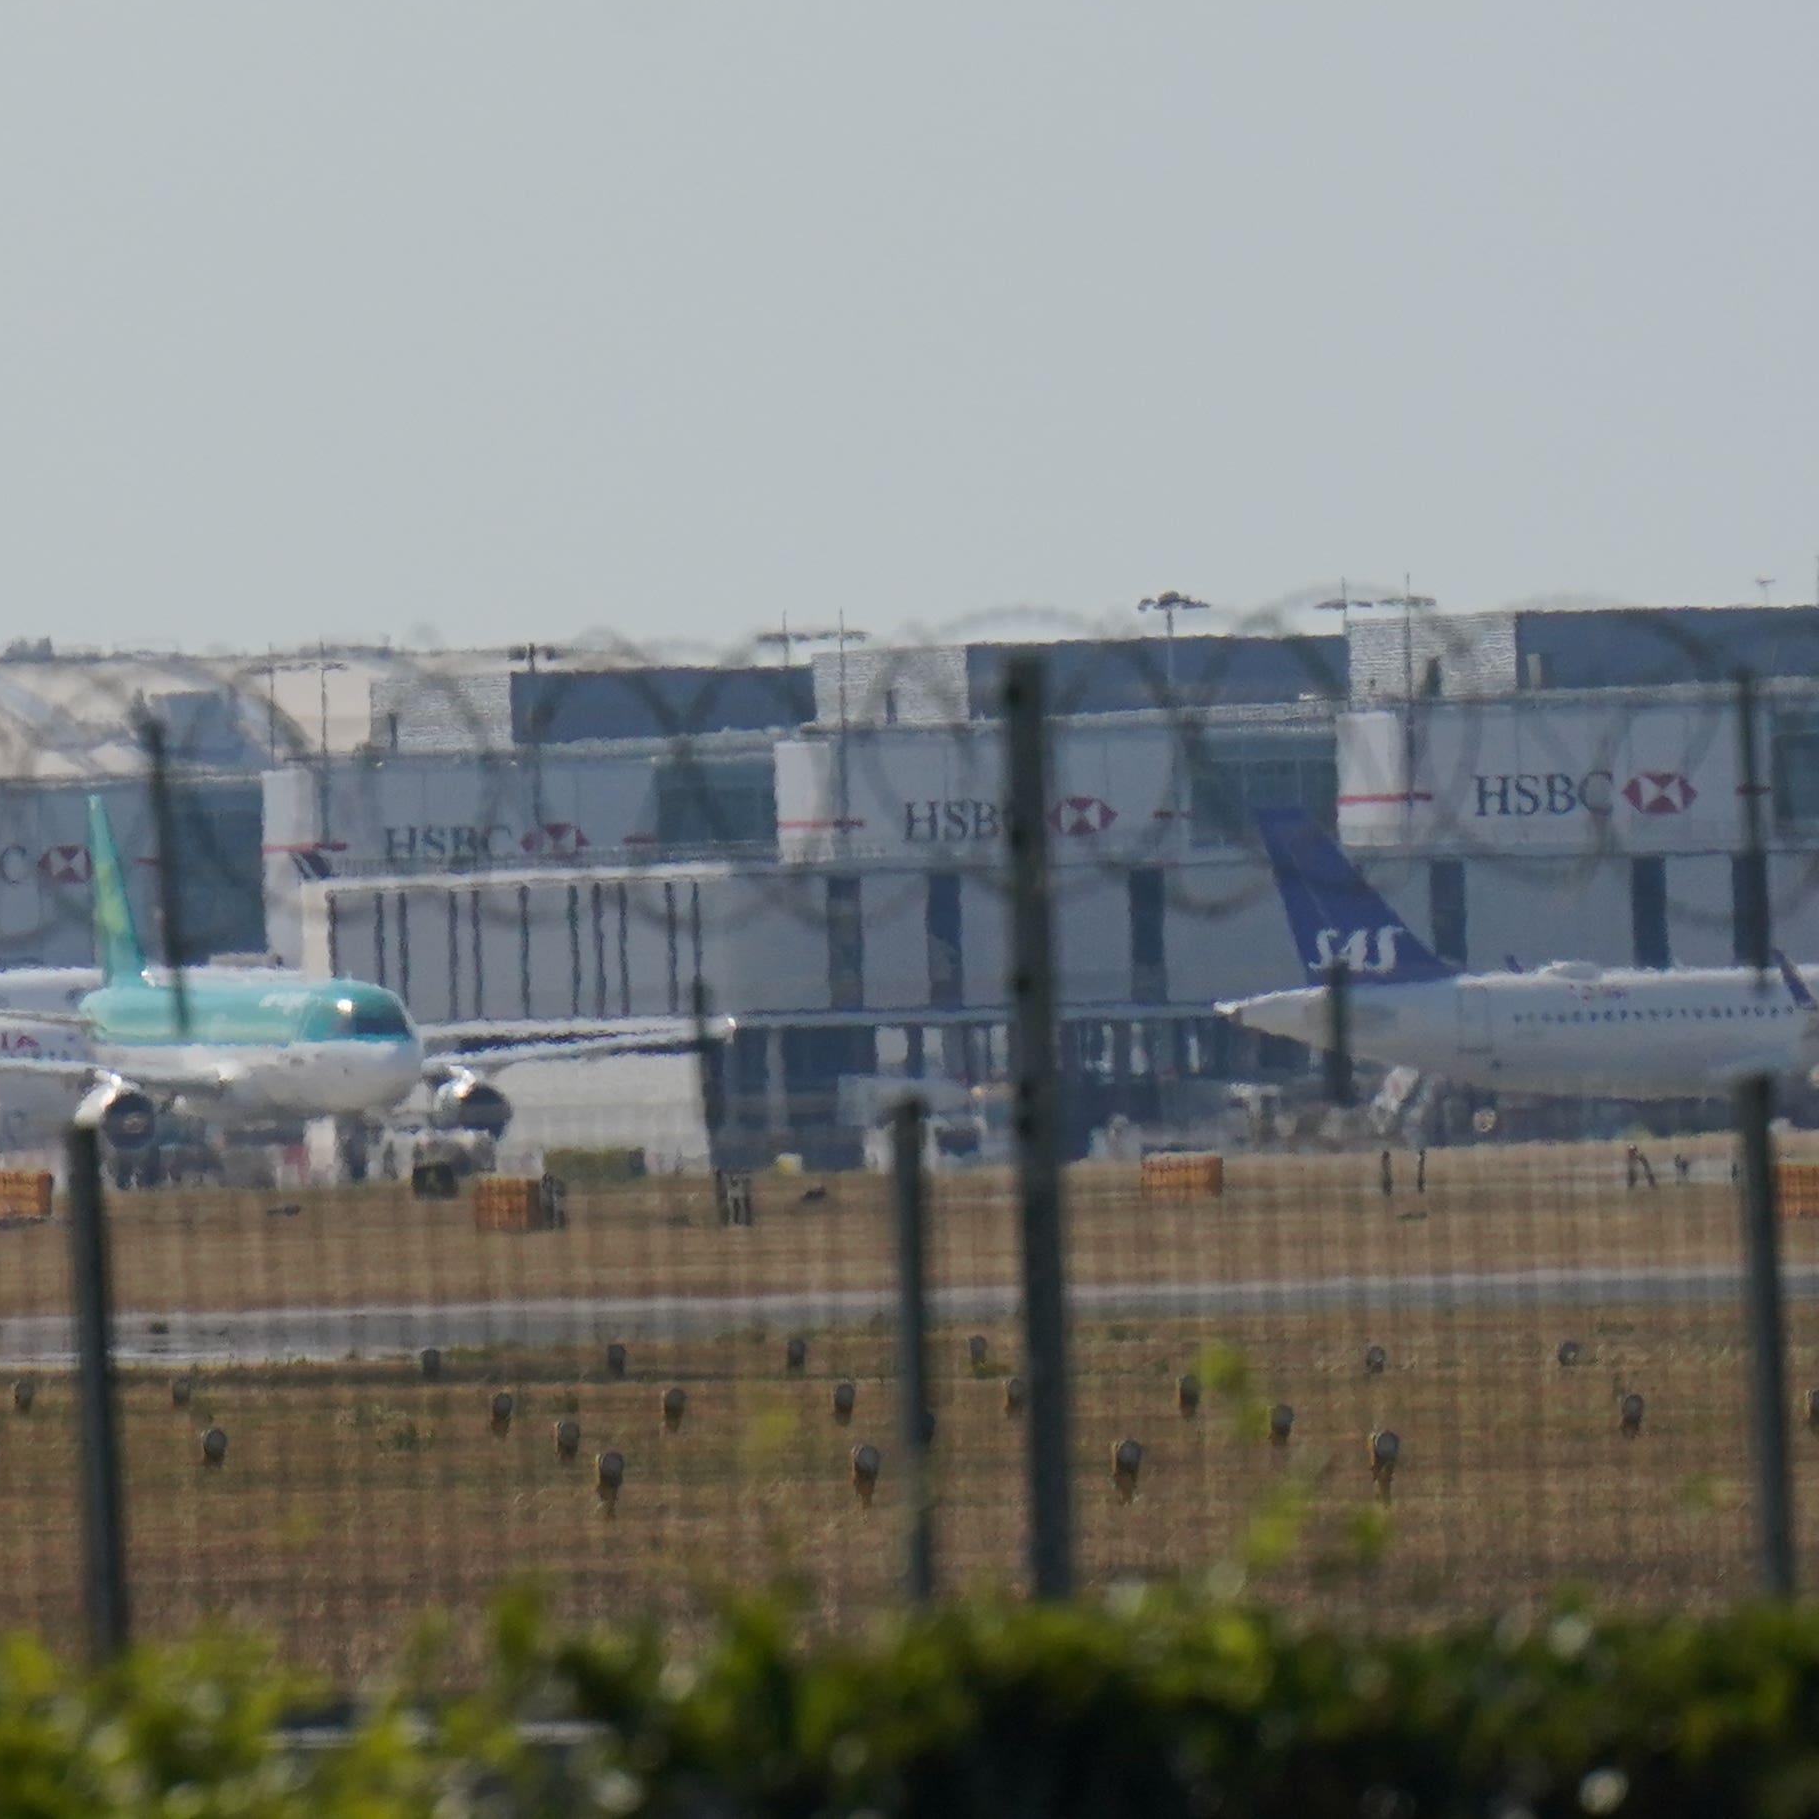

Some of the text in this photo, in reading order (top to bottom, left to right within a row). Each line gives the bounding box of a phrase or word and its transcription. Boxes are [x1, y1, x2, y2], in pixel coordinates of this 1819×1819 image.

[1471, 770, 1614, 817] HSBC
[902, 798, 1004, 843] HSB
[384, 825, 517, 863] HSBC
[1308, 925, 1404, 974] SAS
